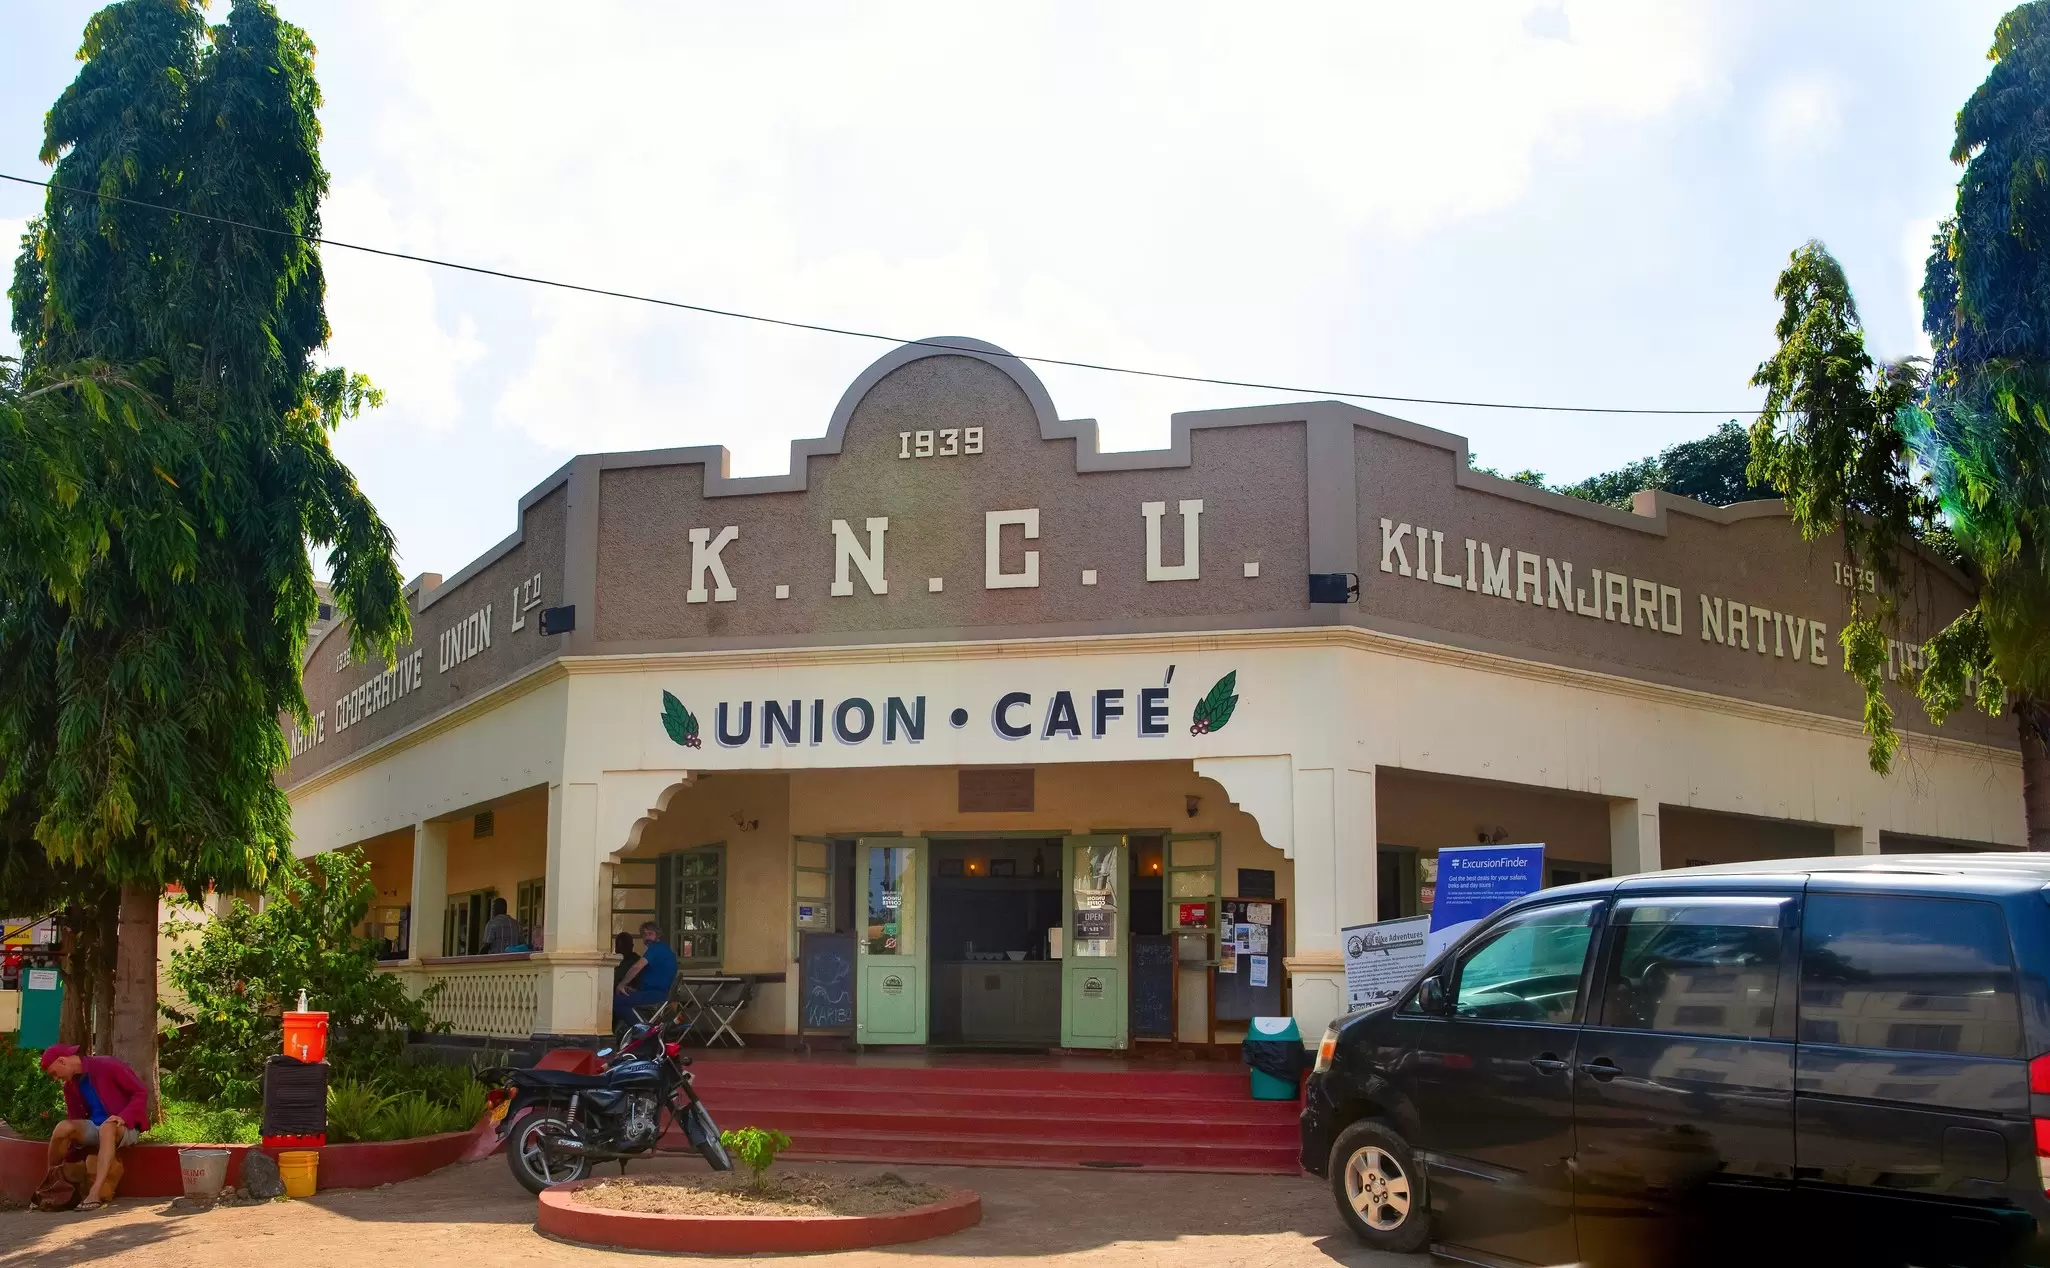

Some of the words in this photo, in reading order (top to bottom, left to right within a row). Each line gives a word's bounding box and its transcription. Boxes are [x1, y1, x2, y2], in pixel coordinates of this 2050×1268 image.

[899, 426, 984, 459] 1939
[1379, 517, 1682, 636] KILIMANJARO
[1700, 593, 1828, 666] NATIVE
[439, 603, 492, 674] UNION
[511, 572, 541, 633] LTD
[714, 695, 926, 747] UNION
[991, 665, 1176, 741] CAFÉ
[1462, 857, 1528, 869] ExcursionFinder
[1389, 932, 1423, 942] Adventures
